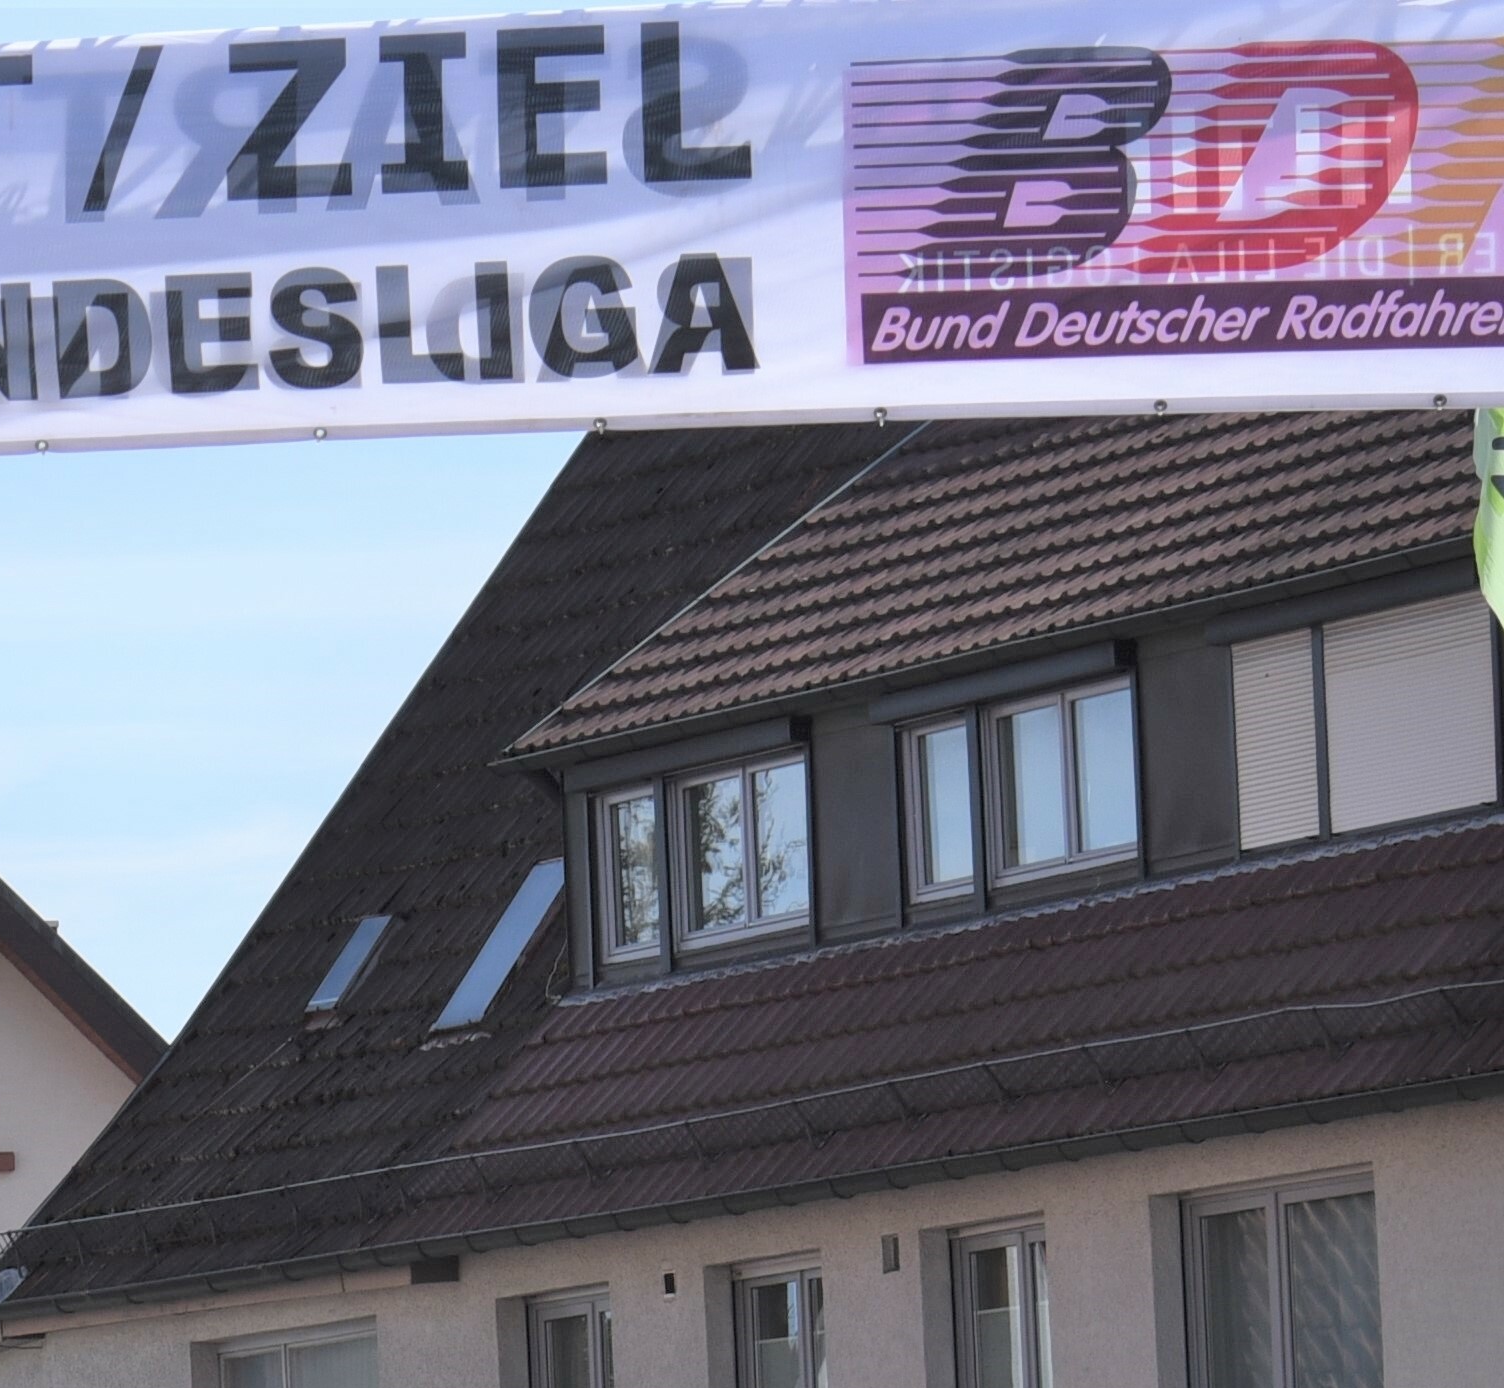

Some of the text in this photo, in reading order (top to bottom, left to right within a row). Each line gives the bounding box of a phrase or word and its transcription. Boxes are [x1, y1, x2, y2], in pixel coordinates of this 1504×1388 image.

[227, 21, 752, 201] ZIEL
[871, 300, 1010, 354] Bund
[1015, 294, 1271, 349] Deutscher
